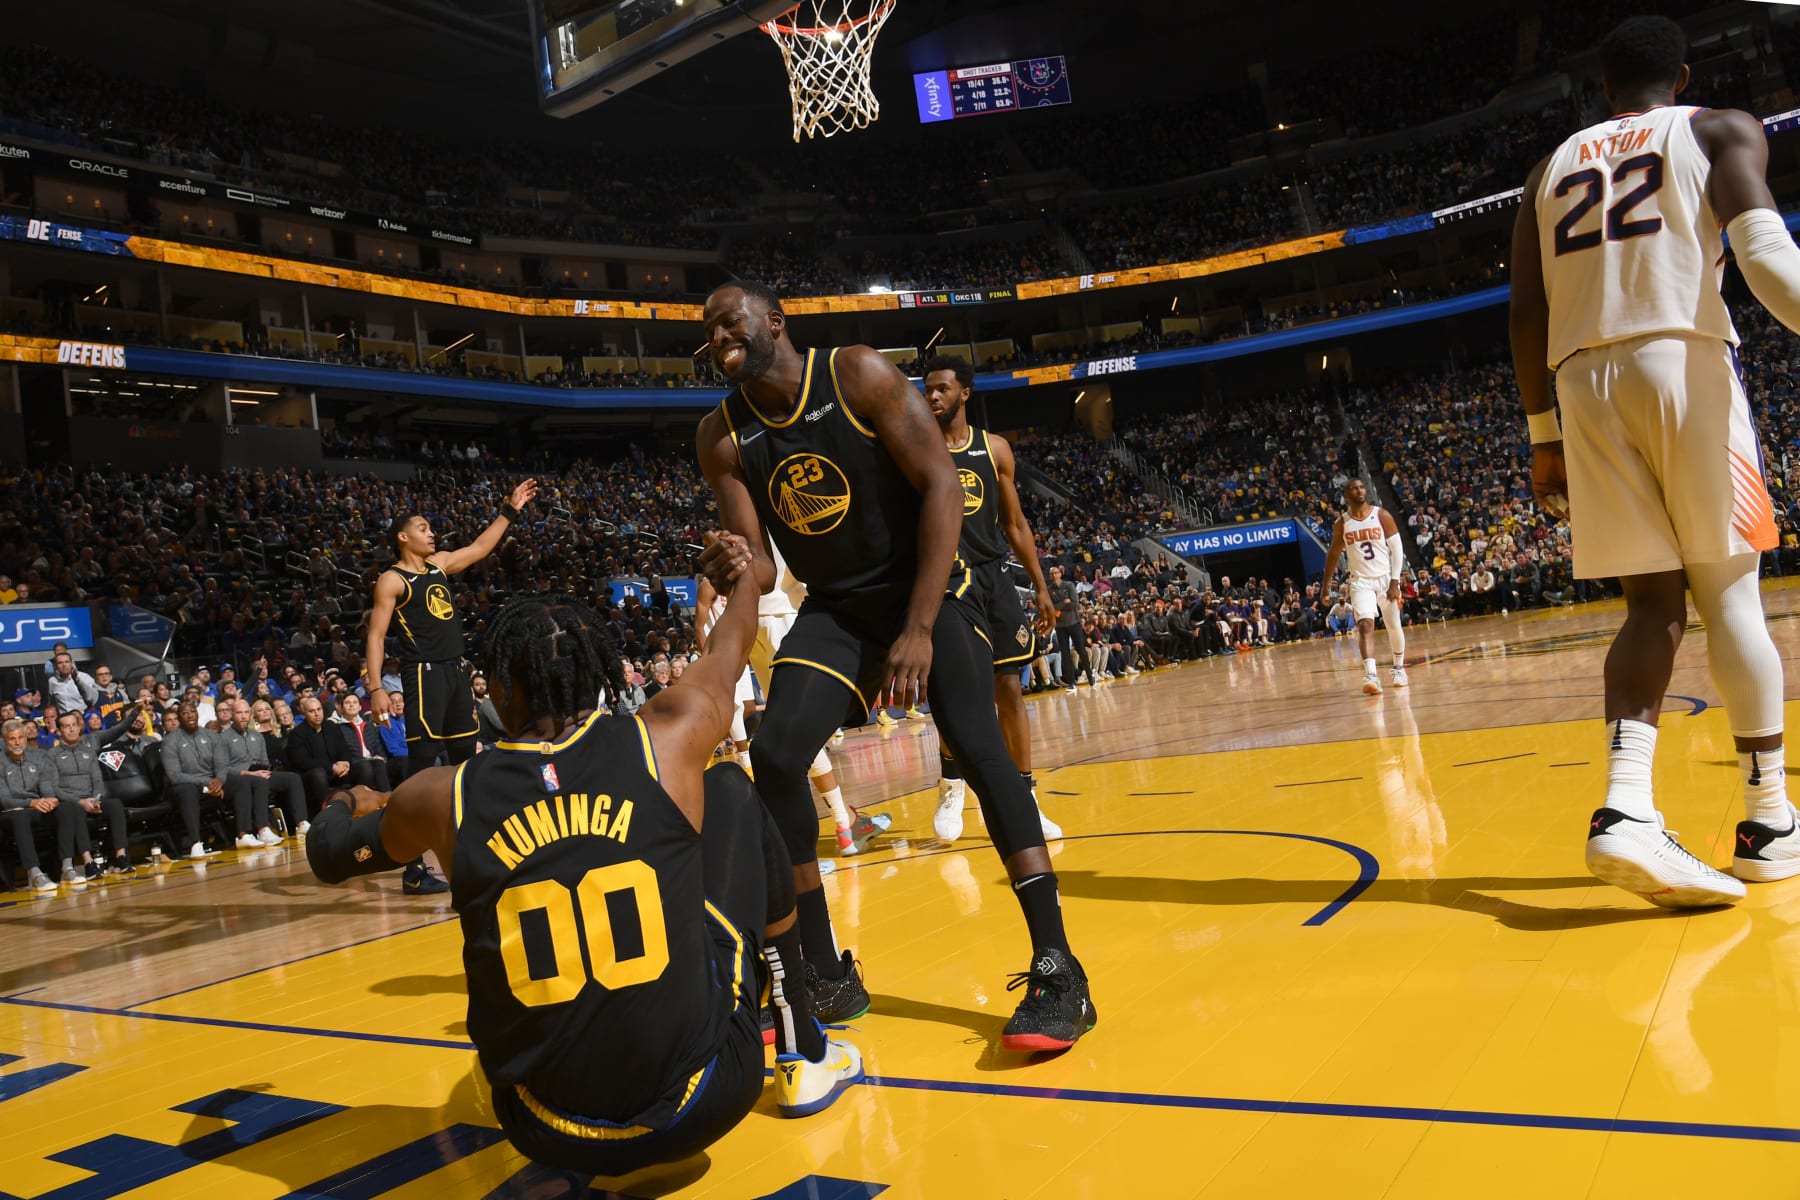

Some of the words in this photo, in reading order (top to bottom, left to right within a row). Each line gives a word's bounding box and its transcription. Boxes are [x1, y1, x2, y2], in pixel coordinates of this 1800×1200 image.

[924, 76, 942, 117] xfinity
[973, 101, 987, 111] 7/11
[1579, 128, 1653, 165] AYTON
[69, 159, 129, 178] ORACLE
[160, 179, 206, 196] accenture
[310, 206, 346, 219] verizon
[1554, 152, 1663, 257] 22
[27, 219, 51, 240] DE
[431, 230, 472, 245] ticketmaster
[1080, 274, 1095, 289] DE
[988, 290, 1012, 298] FINAL
[574, 299, 589, 315] DE
[58, 340, 126, 369] DEFENS
[1087, 356, 1137, 376] DEFENSE
[804, 402, 835, 422] Rakuten
[787, 458, 824, 489] 23
[1167, 540, 1190, 553] AY
[1193, 536, 1220, 550] HAS
[1223, 533, 1243, 546] NO
[1246, 527, 1290, 543] LIMITS
[1345, 527, 1381, 545] SUNS
[1360, 541, 1375, 560] 3
[435, 587, 445, 598] 3
[0, 617, 71, 643] S5
[486, 793, 634, 871] KUMINGA
[496, 859, 670, 1007] 00
